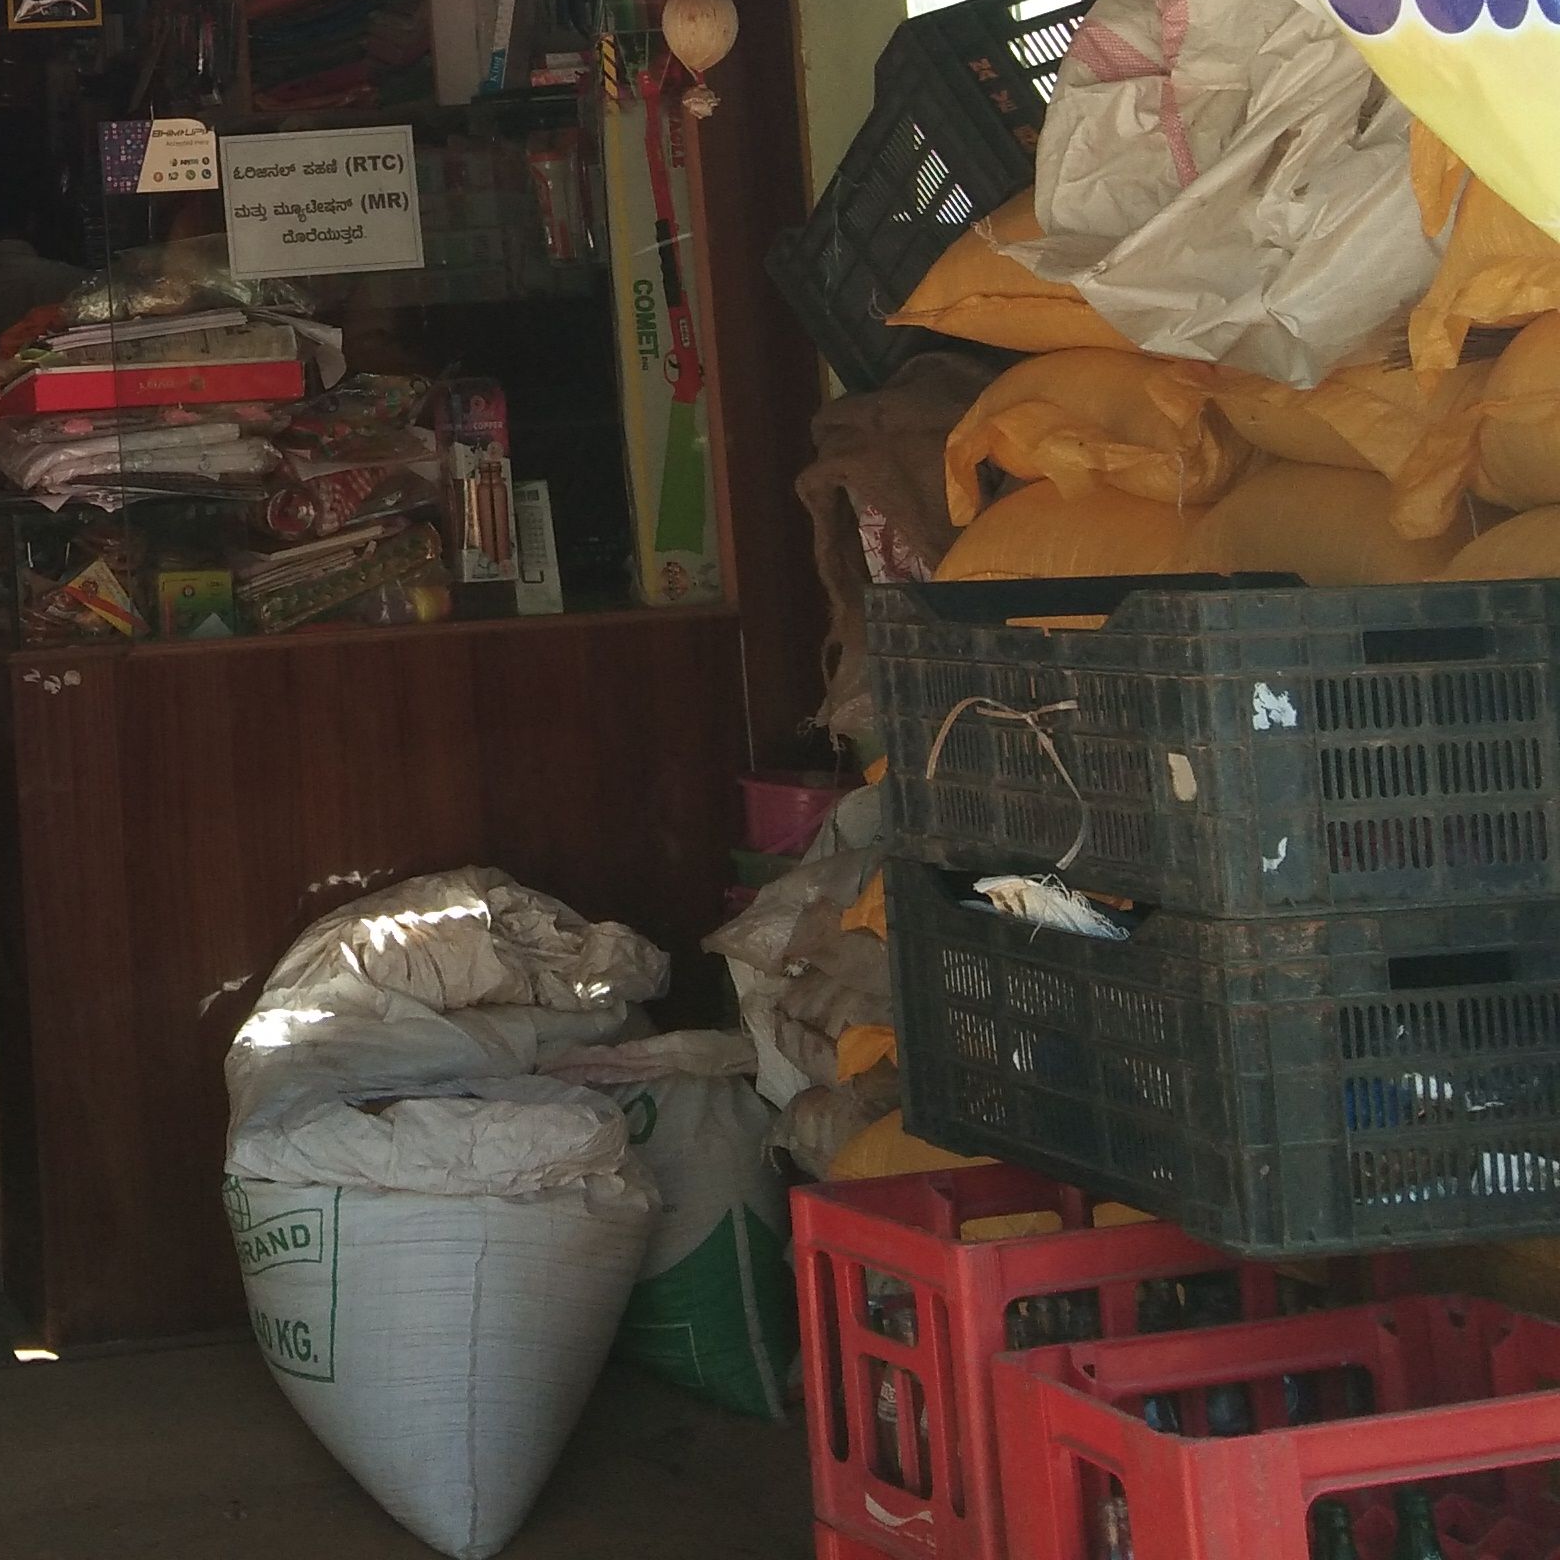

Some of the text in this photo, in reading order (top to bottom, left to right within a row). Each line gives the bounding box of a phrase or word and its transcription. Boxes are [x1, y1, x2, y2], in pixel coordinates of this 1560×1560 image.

[345, 153, 405, 177] (RTC)
[360, 191, 410, 214] (MR)
[632, 278, 660, 359] COMET
[238, 1223, 312, 1267] RAND
